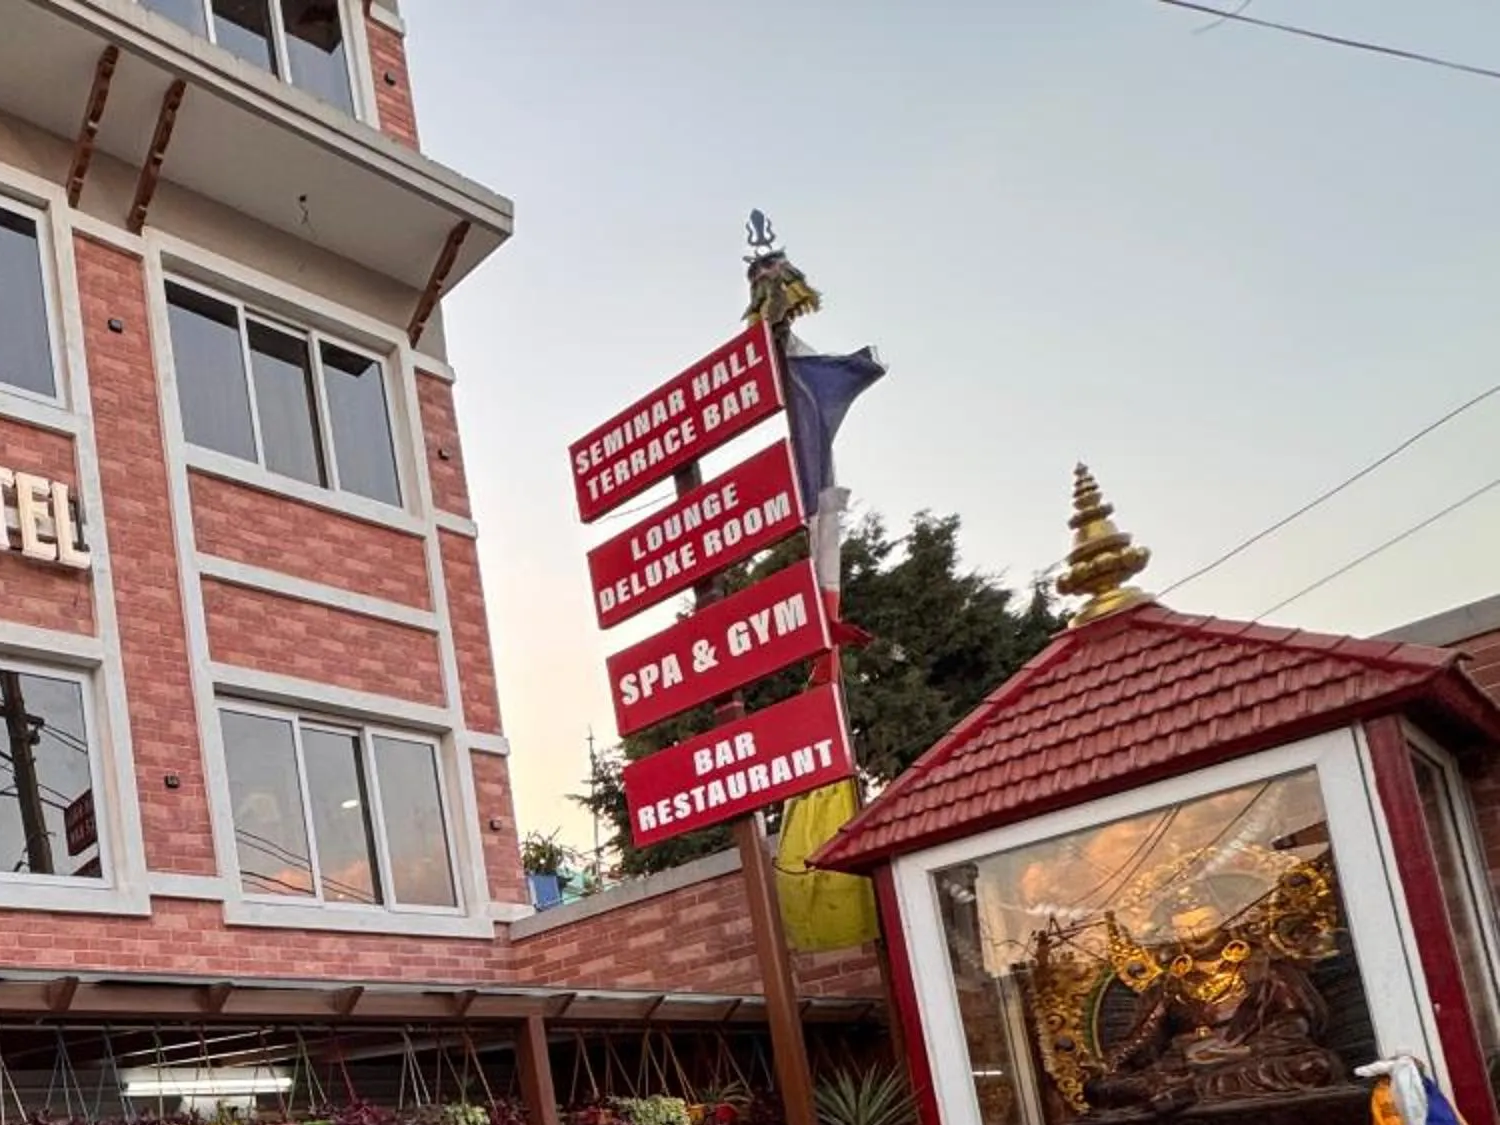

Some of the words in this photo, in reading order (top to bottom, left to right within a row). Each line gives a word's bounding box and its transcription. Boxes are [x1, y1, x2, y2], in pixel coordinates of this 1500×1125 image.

[575, 388, 686, 475] SEMINAR
[691, 341, 763, 401] HALL
[586, 417, 697, 501] TERRACE
[702, 380, 760, 432] BAR
[599, 543, 697, 614] DELUXE
[703, 491, 791, 558] ROOM
[630, 483, 740, 561] LOUNGE
[619, 653, 683, 705] SPA
[691, 639, 719, 673] &
[727, 593, 807, 657] GYM
[638, 739, 833, 832] RESTAURANT
[693, 732, 757, 776] BAR
